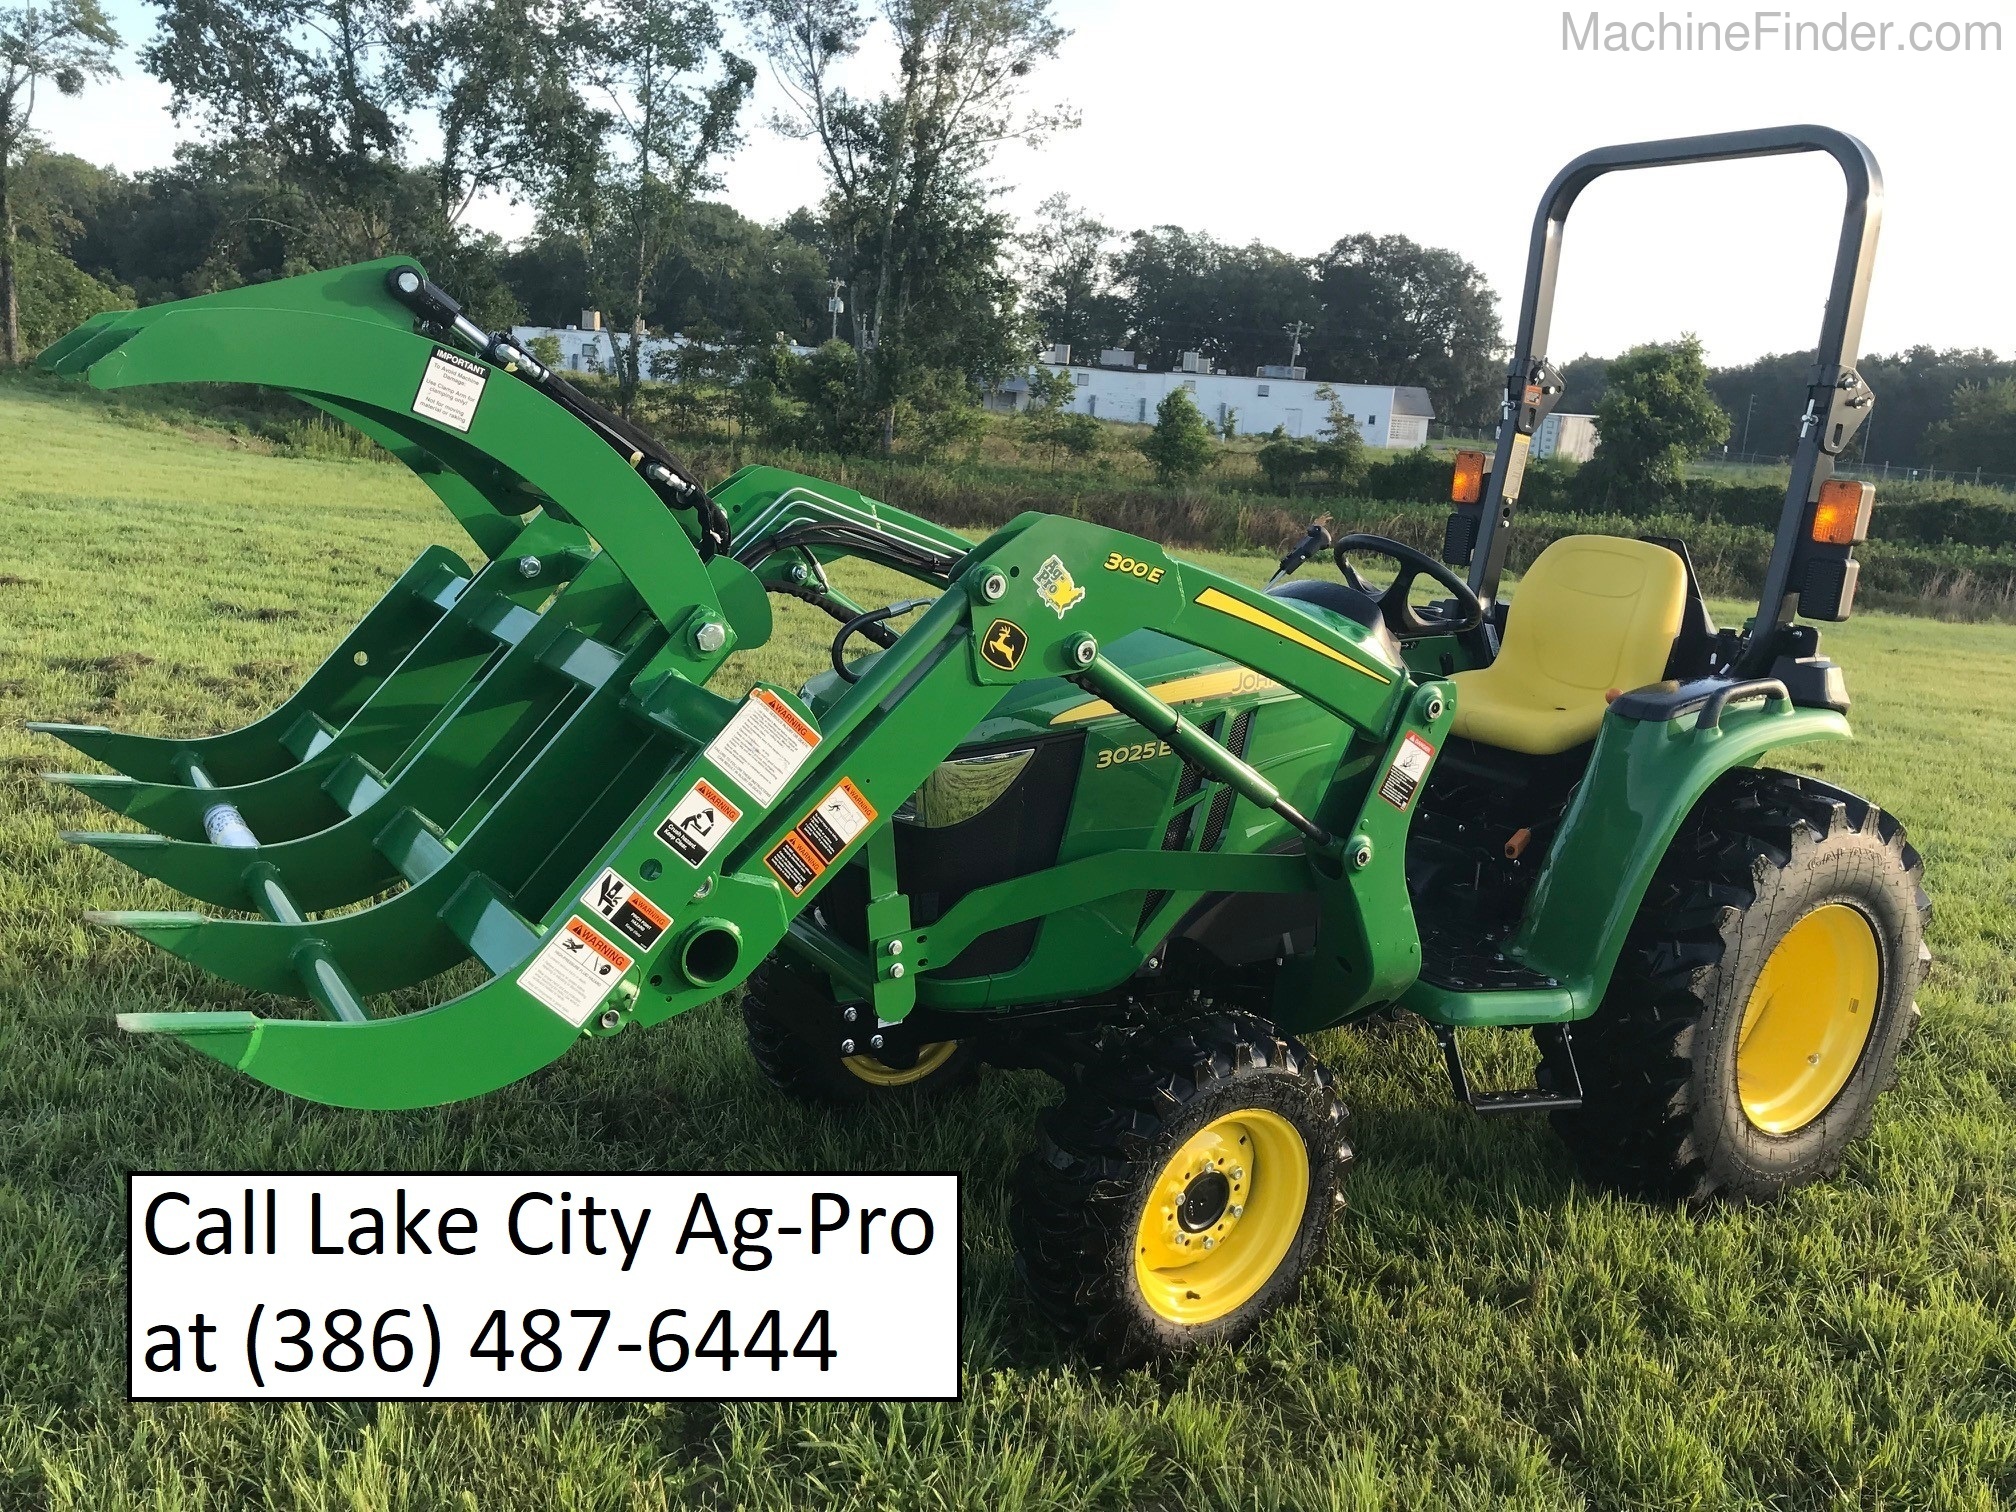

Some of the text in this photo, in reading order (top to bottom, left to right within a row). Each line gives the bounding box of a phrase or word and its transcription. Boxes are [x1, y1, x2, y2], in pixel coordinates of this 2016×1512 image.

[436, 349, 485, 374] IMPORTANT
[441, 366, 456, 375] Avoid
[457, 373, 479, 385] Machine
[429, 387, 453, 399] clamping
[437, 383, 454, 393] Clamp
[419, 401, 441, 412] material
[448, 413, 465, 422] raking
[444, 405, 464, 416] moving
[1037, 570, 1058, 594] Pro
[774, 704, 808, 735] WARNING
[1096, 741, 1172, 769] 3025E
[704, 789, 736, 818] WARNING
[848, 789, 873, 815] WARNING
[663, 828, 675, 840] Keep
[668, 823, 681, 836] Crush
[795, 844, 820, 870] WARNING
[637, 901, 665, 925] WARNING
[641, 920, 651, 929] POINT
[580, 929, 626, 966] WARNING
